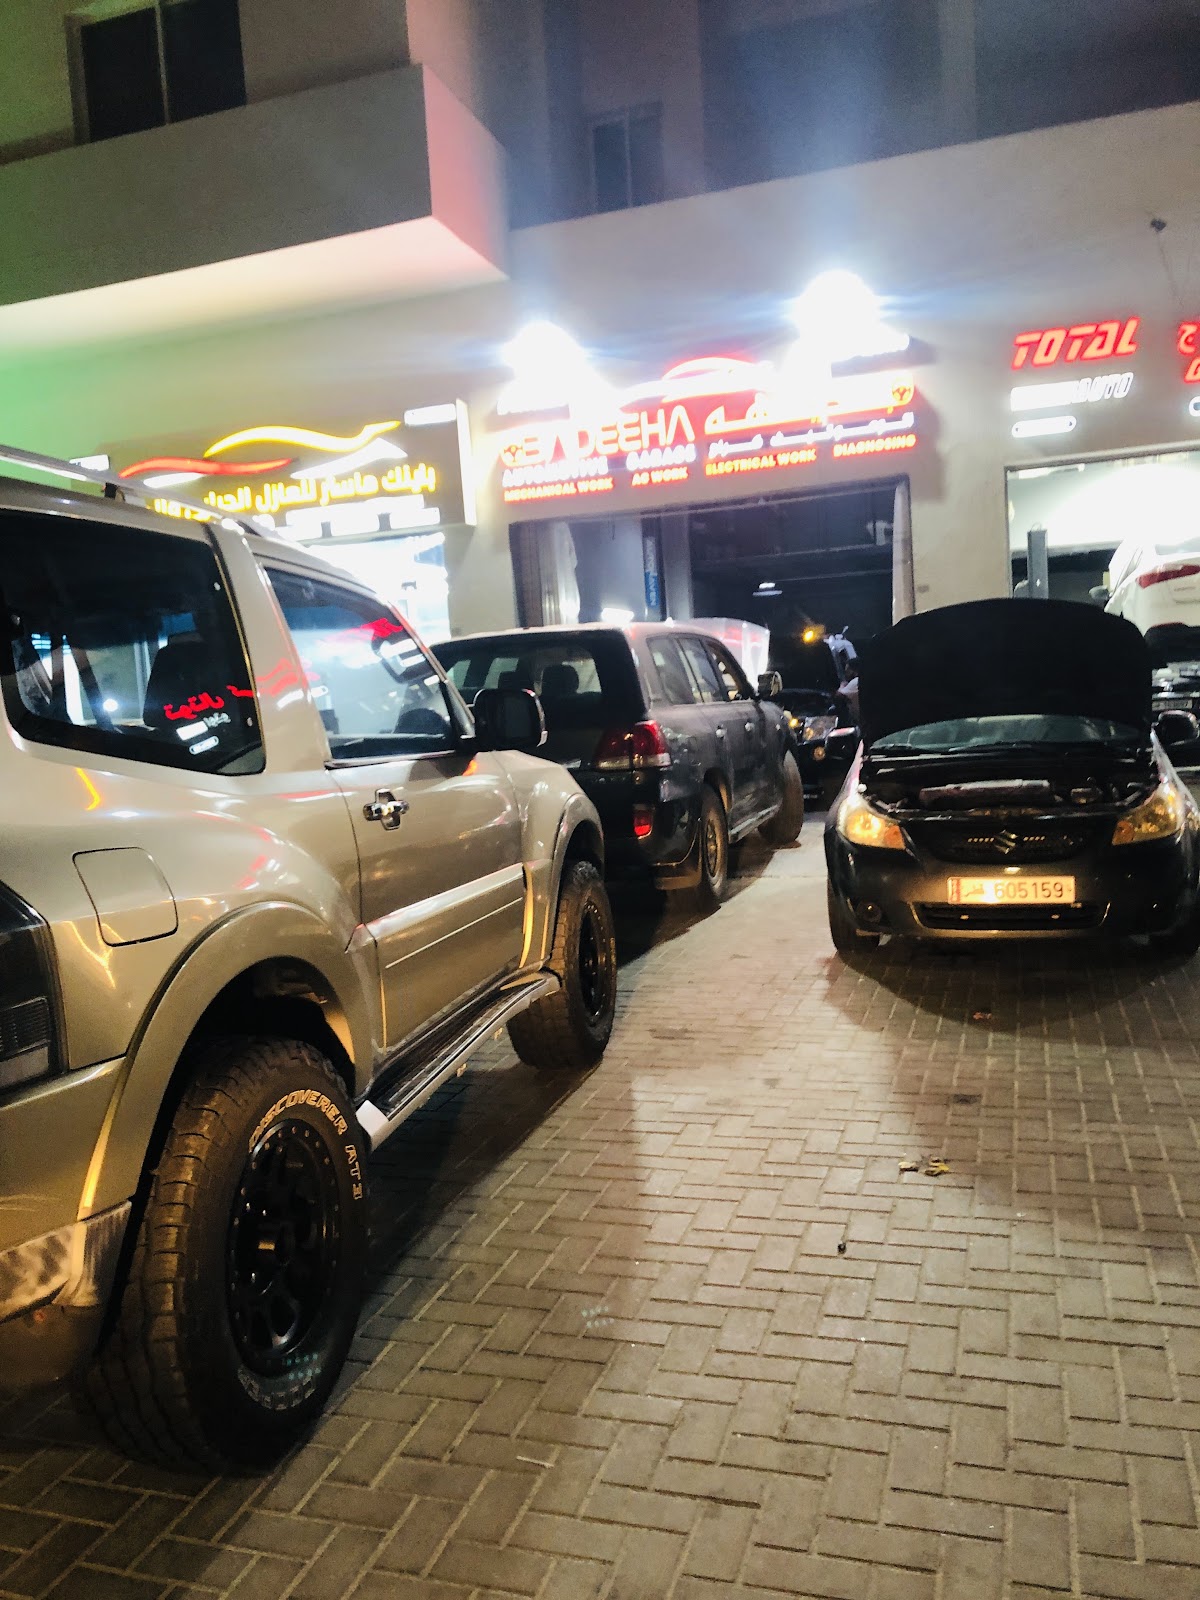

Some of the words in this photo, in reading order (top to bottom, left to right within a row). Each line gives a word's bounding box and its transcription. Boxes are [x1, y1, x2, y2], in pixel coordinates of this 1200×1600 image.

[1012, 318, 1139, 369] TOTAL
[501, 404, 696, 467] BADEEHA
[833, 433, 916, 458] DIAGNOSING
[626, 443, 697, 472] GARAGE
[705, 454, 776, 476] ELECTRICAL
[777, 448, 817, 467] WORK
[503, 482, 576, 502] MECHANICAL
[577, 476, 614, 494] WORK
[651, 466, 689, 484] WORK
[993, 881, 1064, 899] 605159
[248, 1088, 349, 1154] DISCOVERER
